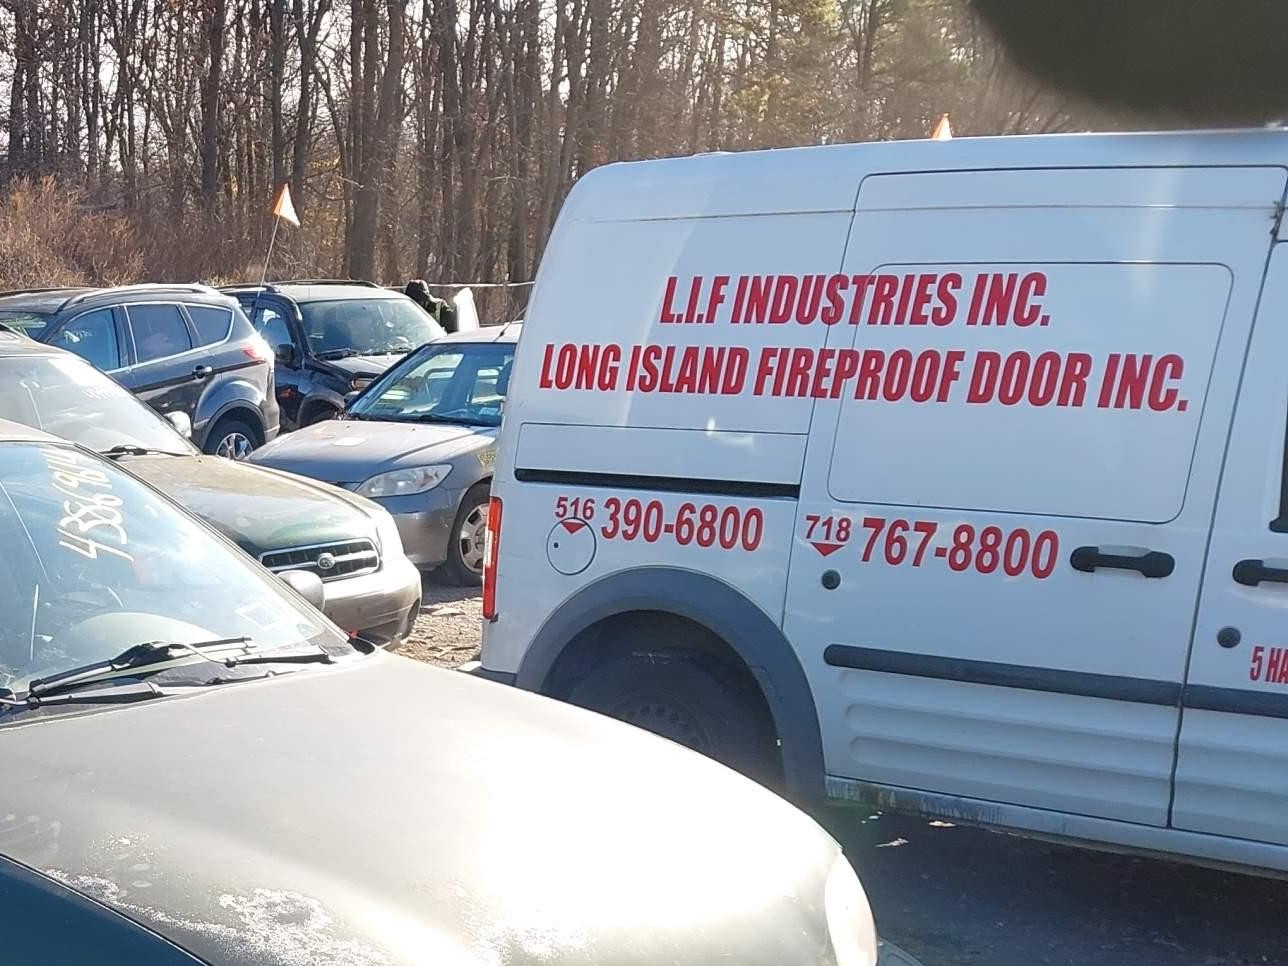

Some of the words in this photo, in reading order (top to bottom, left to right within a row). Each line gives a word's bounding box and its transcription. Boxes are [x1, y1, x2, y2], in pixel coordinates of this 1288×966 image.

[659, 275, 730, 324] L.I.F
[730, 273, 963, 326] INDUSTRIES
[966, 272, 1051, 327] INC.
[539, 343, 621, 391] LONG
[625, 344, 750, 396] ISLAND
[753, 347, 965, 403] FIREPROOF
[966, 350, 1093, 408] DOOR
[1097, 353, 1189, 412] INC.
[555, 496, 595, 521] 516
[601, 498, 764, 551] 390-6800
[805, 514, 851, 542] 718
[861, 517, 1060, 579] 767-8800
[1250, 646, 1265, 681] 5
